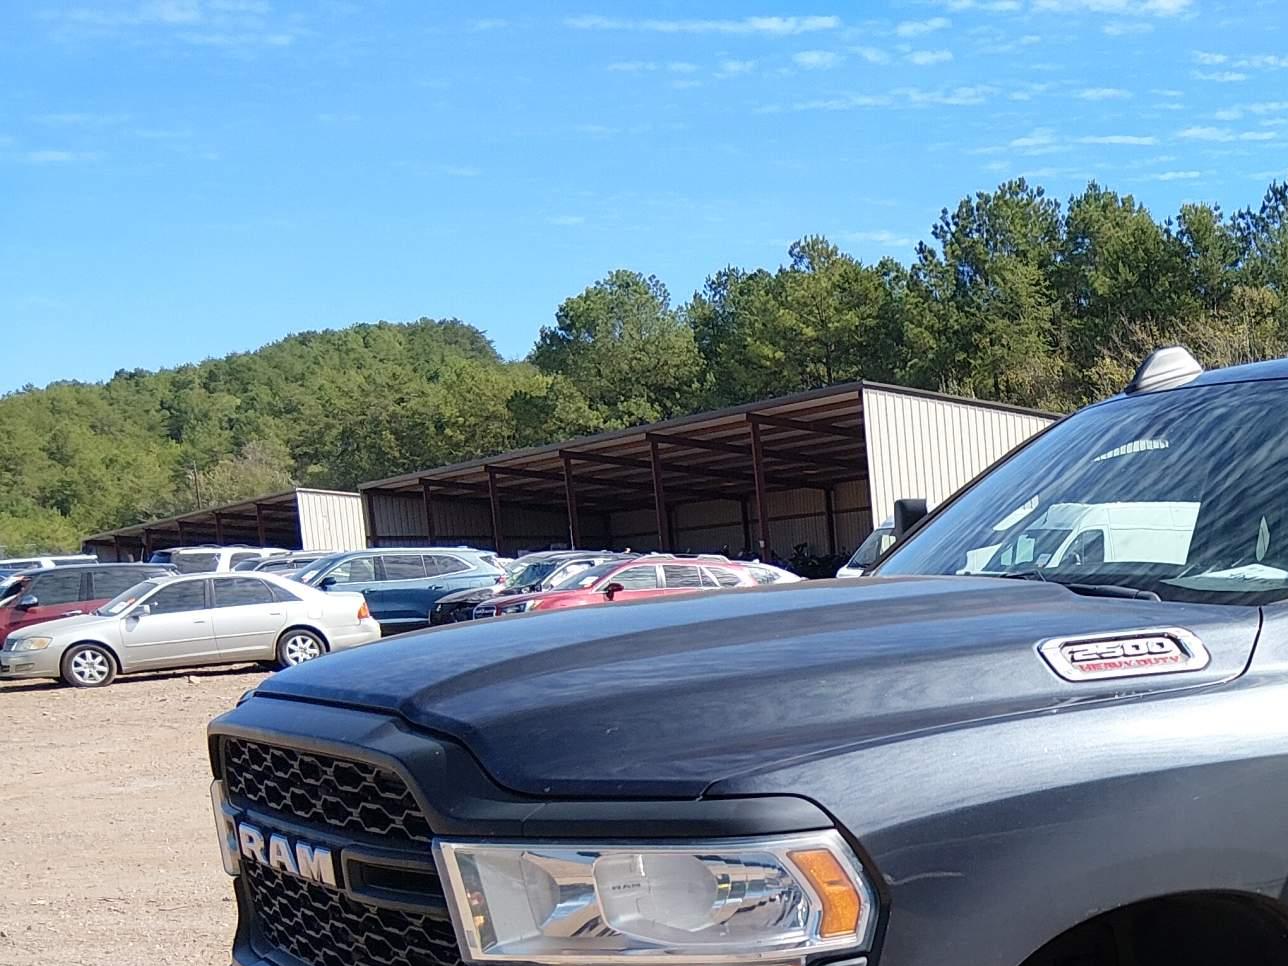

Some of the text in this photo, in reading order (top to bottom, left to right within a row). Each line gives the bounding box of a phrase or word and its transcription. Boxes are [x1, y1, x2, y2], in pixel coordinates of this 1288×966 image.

[1069, 641, 1173, 662] 2500
[1079, 656, 1179, 672] HEAVY DUTY
[238, 821, 337, 887] RAM
